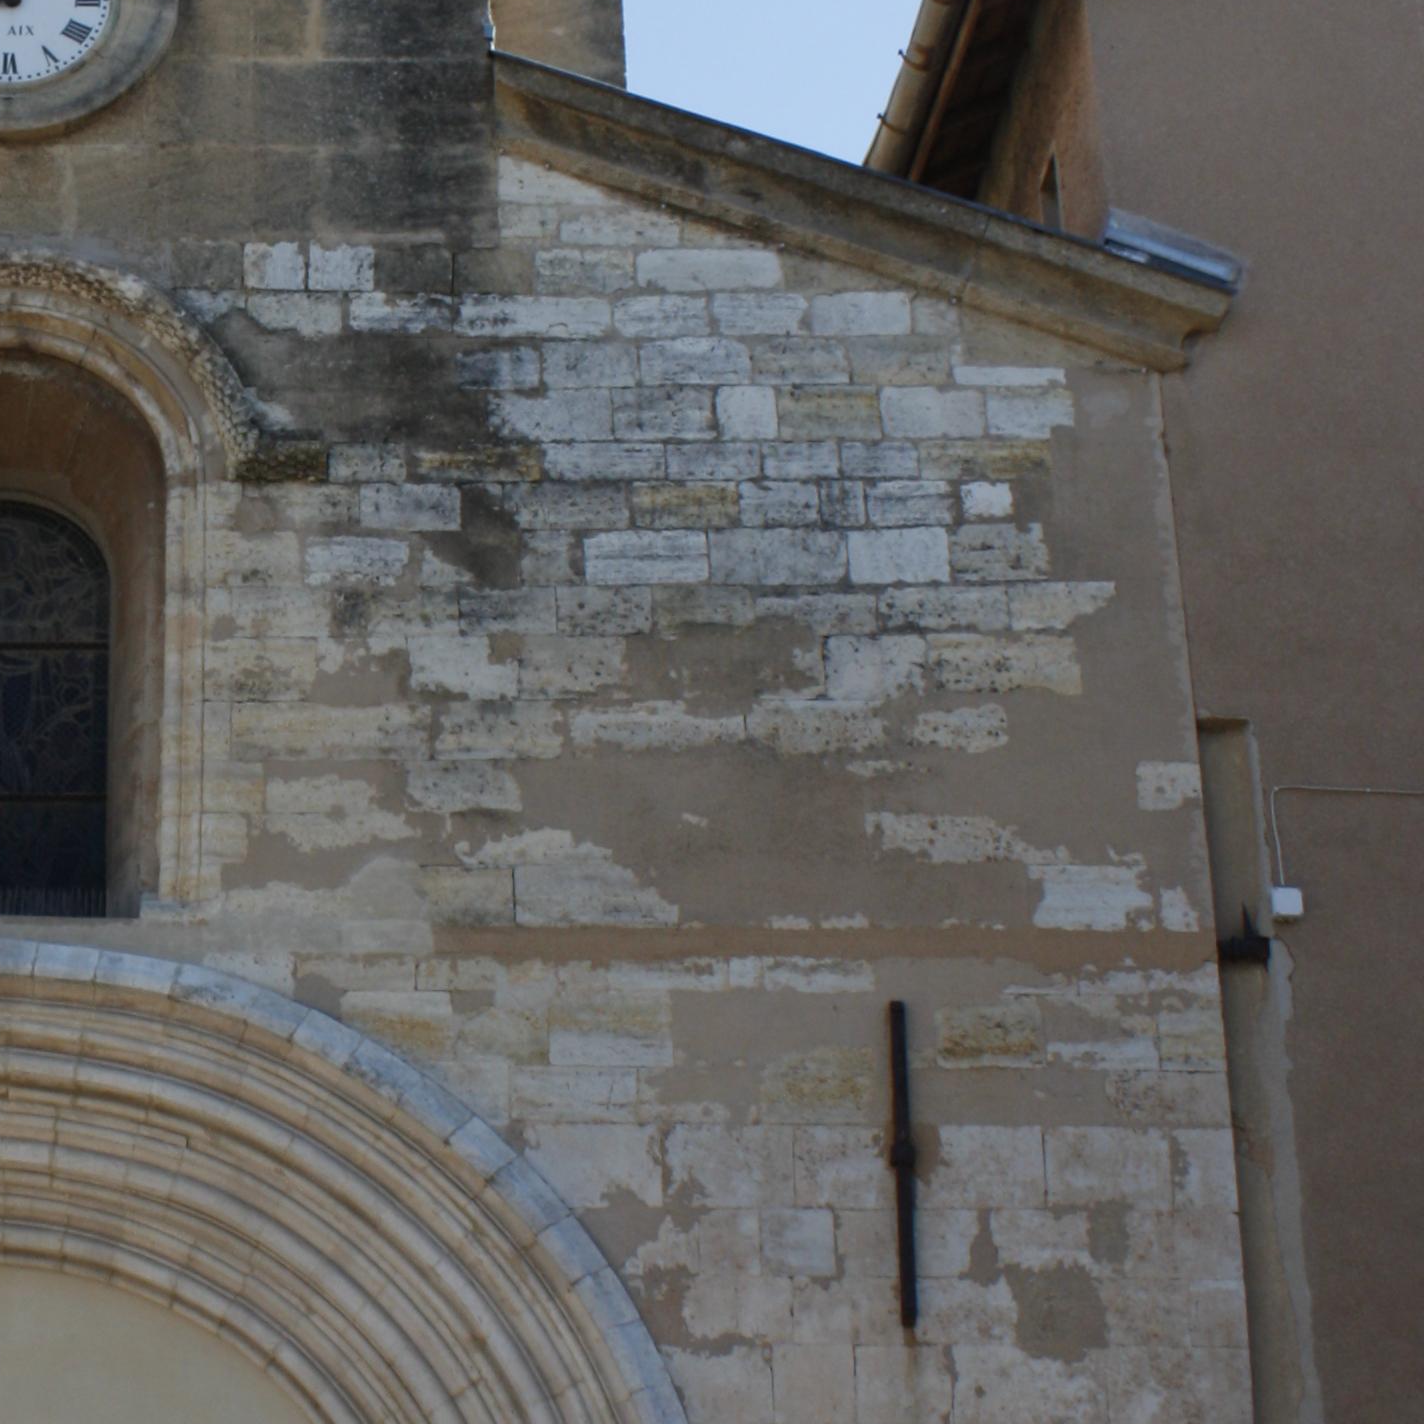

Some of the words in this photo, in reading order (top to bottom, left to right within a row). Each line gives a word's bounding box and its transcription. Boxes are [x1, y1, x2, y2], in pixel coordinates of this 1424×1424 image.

[7, 25, 34, 36] AIX
[1, 52, 18, 75] VI
[41, 45, 60, 67] V
